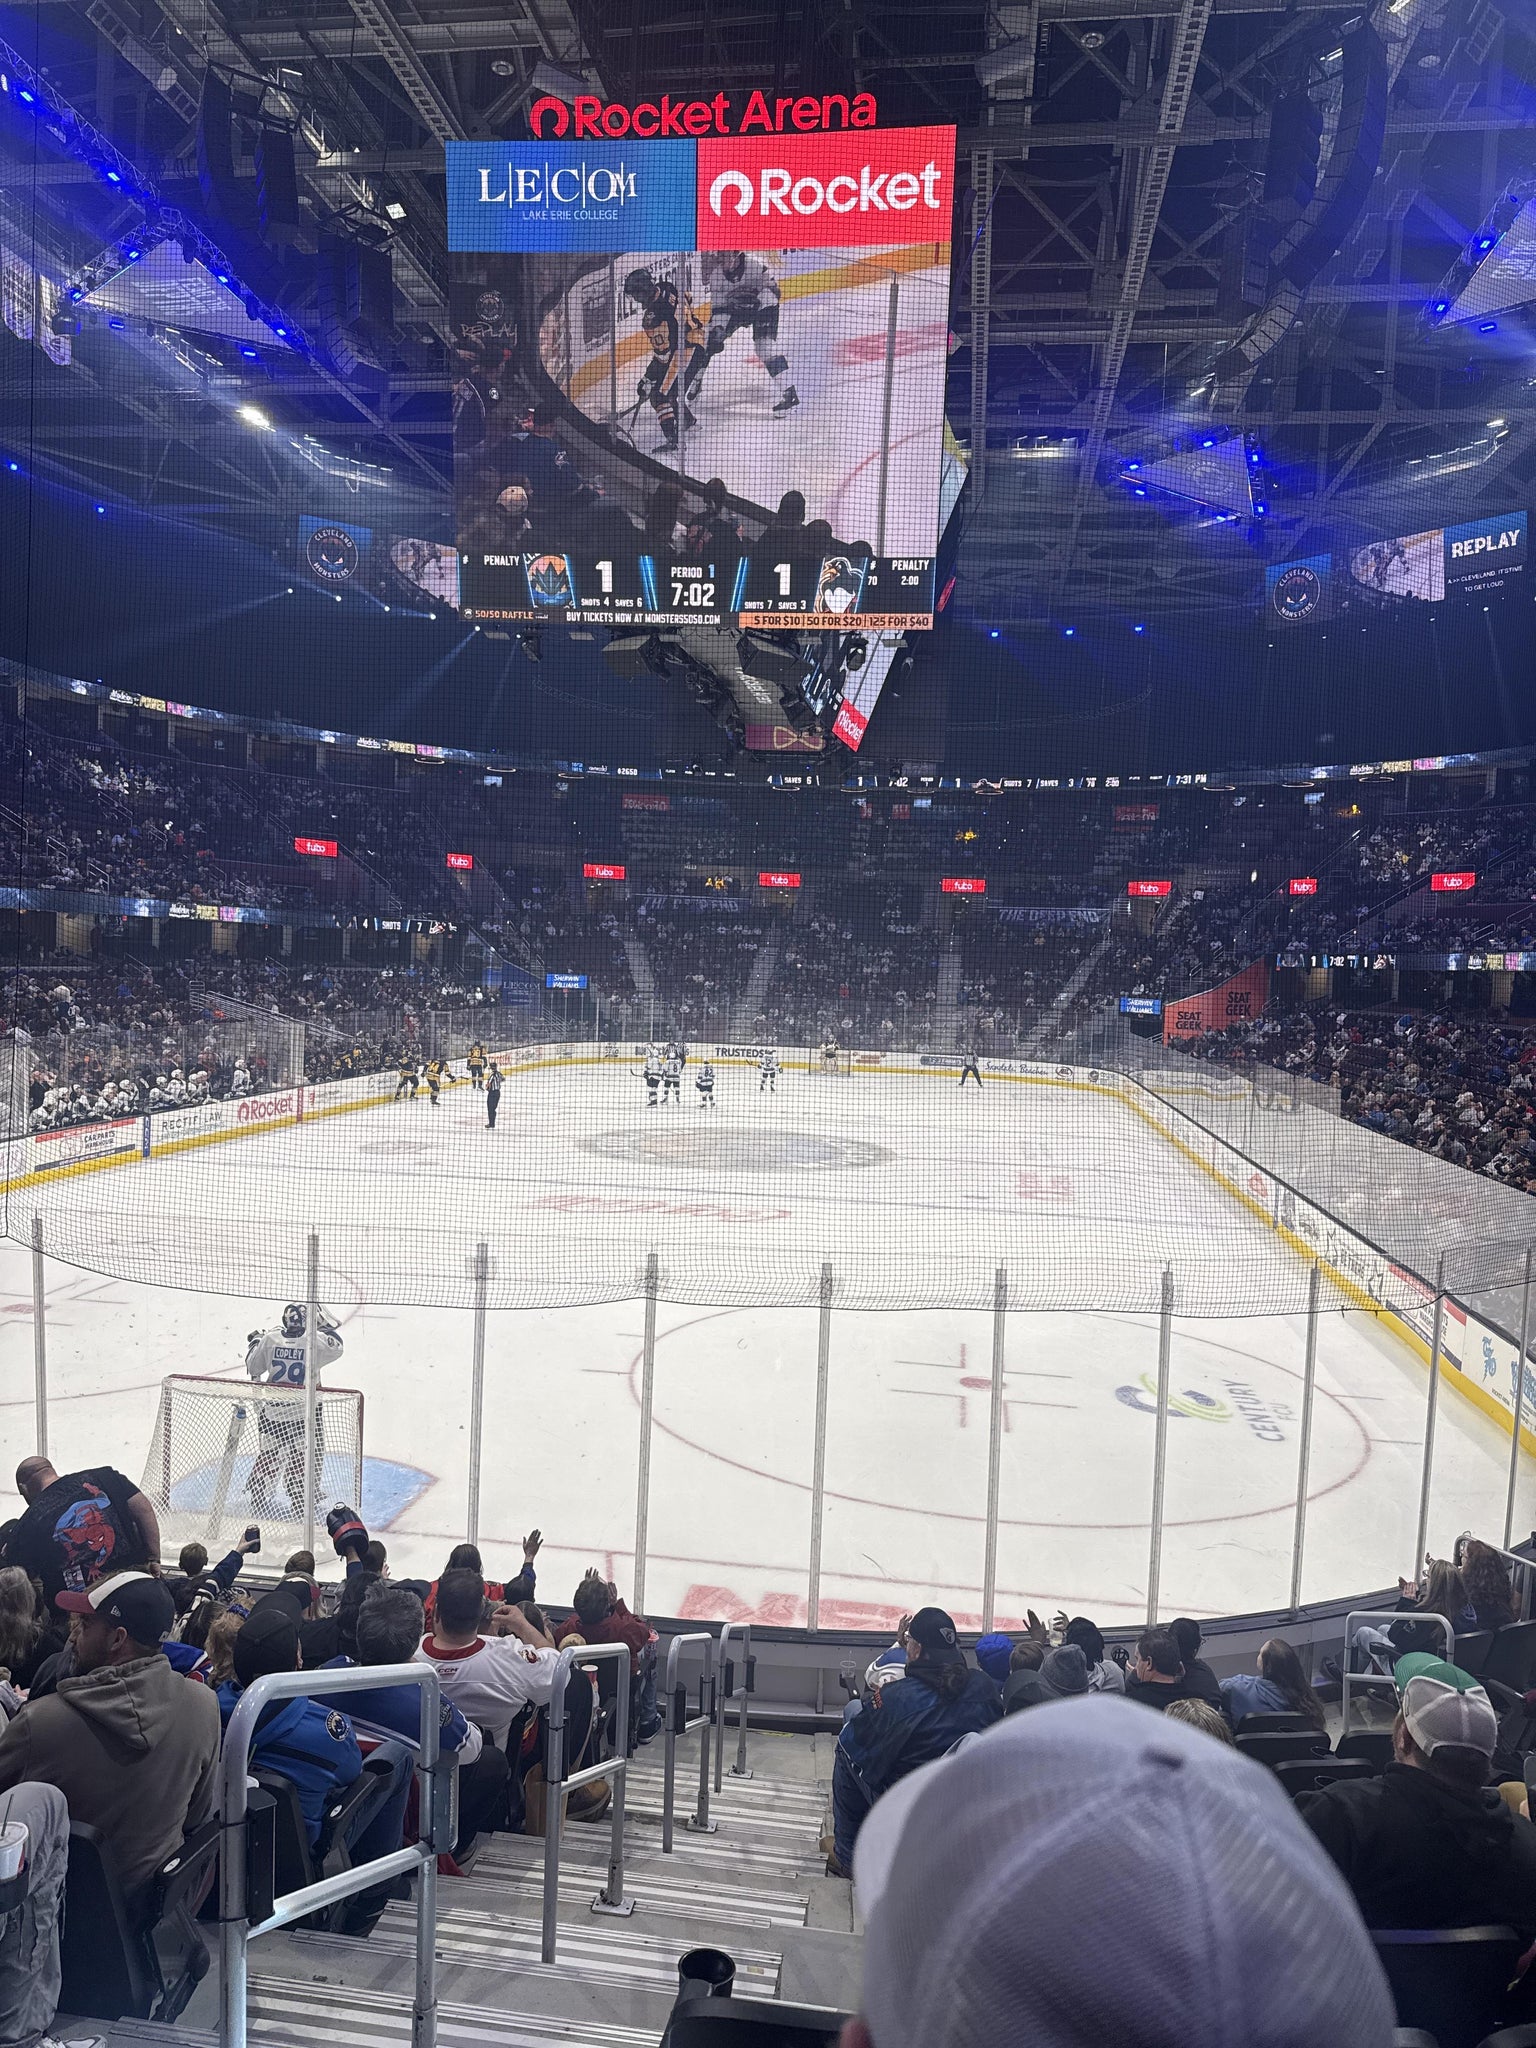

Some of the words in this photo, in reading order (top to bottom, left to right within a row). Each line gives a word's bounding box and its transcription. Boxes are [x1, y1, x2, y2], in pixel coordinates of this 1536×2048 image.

[574, 91, 730, 138] Rocket
[740, 90, 878, 133] Arena
[761, 161, 941, 216] Rocket
[522, 210, 548, 222] LAKE
[550, 210, 572, 221] ERIE
[574, 209, 619, 221] COLLEGE
[313, 528, 353, 548] CLEVELAND
[1451, 529, 1521, 559] REPLAY
[484, 555, 520, 566] PENALTY
[891, 560, 930, 571] PENALTY
[312, 562, 350, 579] MONSTERS
[671, 567, 703, 578] PERIOD
[708, 564, 715, 578] 1
[595, 560, 613, 593] 1
[773, 563, 791, 596] 1
[867, 576, 878, 586] 70
[900, 576, 919, 586] 2:00
[671, 582, 715, 607] 7:02
[581, 598, 600, 606] SHOTS
[603, 597, 610, 606] 4
[615, 599, 634, 607] SAVES
[636, 597, 643, 607] 6
[744, 601, 764, 610] SHOTS
[767, 600, 773, 610] 7
[778, 601, 798, 610] SAVES
[800, 600, 807, 610] 3
[475, 610, 500, 619] 50/50
[502, 610, 534, 620] RAFFLE
[566, 611, 581, 622] BUY
[583, 611, 613, 622] TICKETS
[615, 612, 632, 623] NOW
[633, 612, 643, 623] AT
[754, 616, 760, 625] 5
[762, 616, 781, 625] FOR
[784, 616, 801, 626] $10
[806, 616, 820, 626] 50
[822, 616, 840, 626] FOR
[843, 616, 862, 627] $20
[869, 616, 886, 627] 125
[888, 616, 907, 627] FOR
[909, 616, 929, 627] $40
[139, 695, 166, 712] POWER
[388, 740, 416, 755] POWER
[784, 776, 802, 785] SAVES
[1175, 775, 1192, 784] 7:31
[1195, 774, 1207, 784] PM
[306, 842, 326, 852] fubo
[451, 856, 469, 867] fubo
[595, 867, 614, 877] fubo
[770, 876, 789, 885] fubo
[954, 881, 973, 891] fubo
[1443, 877, 1463, 888] fubo
[1139, 884, 1159, 893] fubo
[382, 920, 401, 930] SHOTS
[1329, 955, 1345, 967] 7:02
[1228, 991, 1251, 1004] SEAT
[1226, 1004, 1251, 1016] GEEK
[1177, 1011, 1202, 1021] SEAT
[1175, 1021, 1202, 1031] GEEK
[251, 1096, 293, 1120] Rocket
[85, 1133, 97, 1142] CAR
[97, 1130, 115, 1139] PARTS
[275, 1348, 303, 1360] COPLEY
[272, 1360, 305, 1384] 29
[1221, 1378, 1285, 1441] CENTURY
